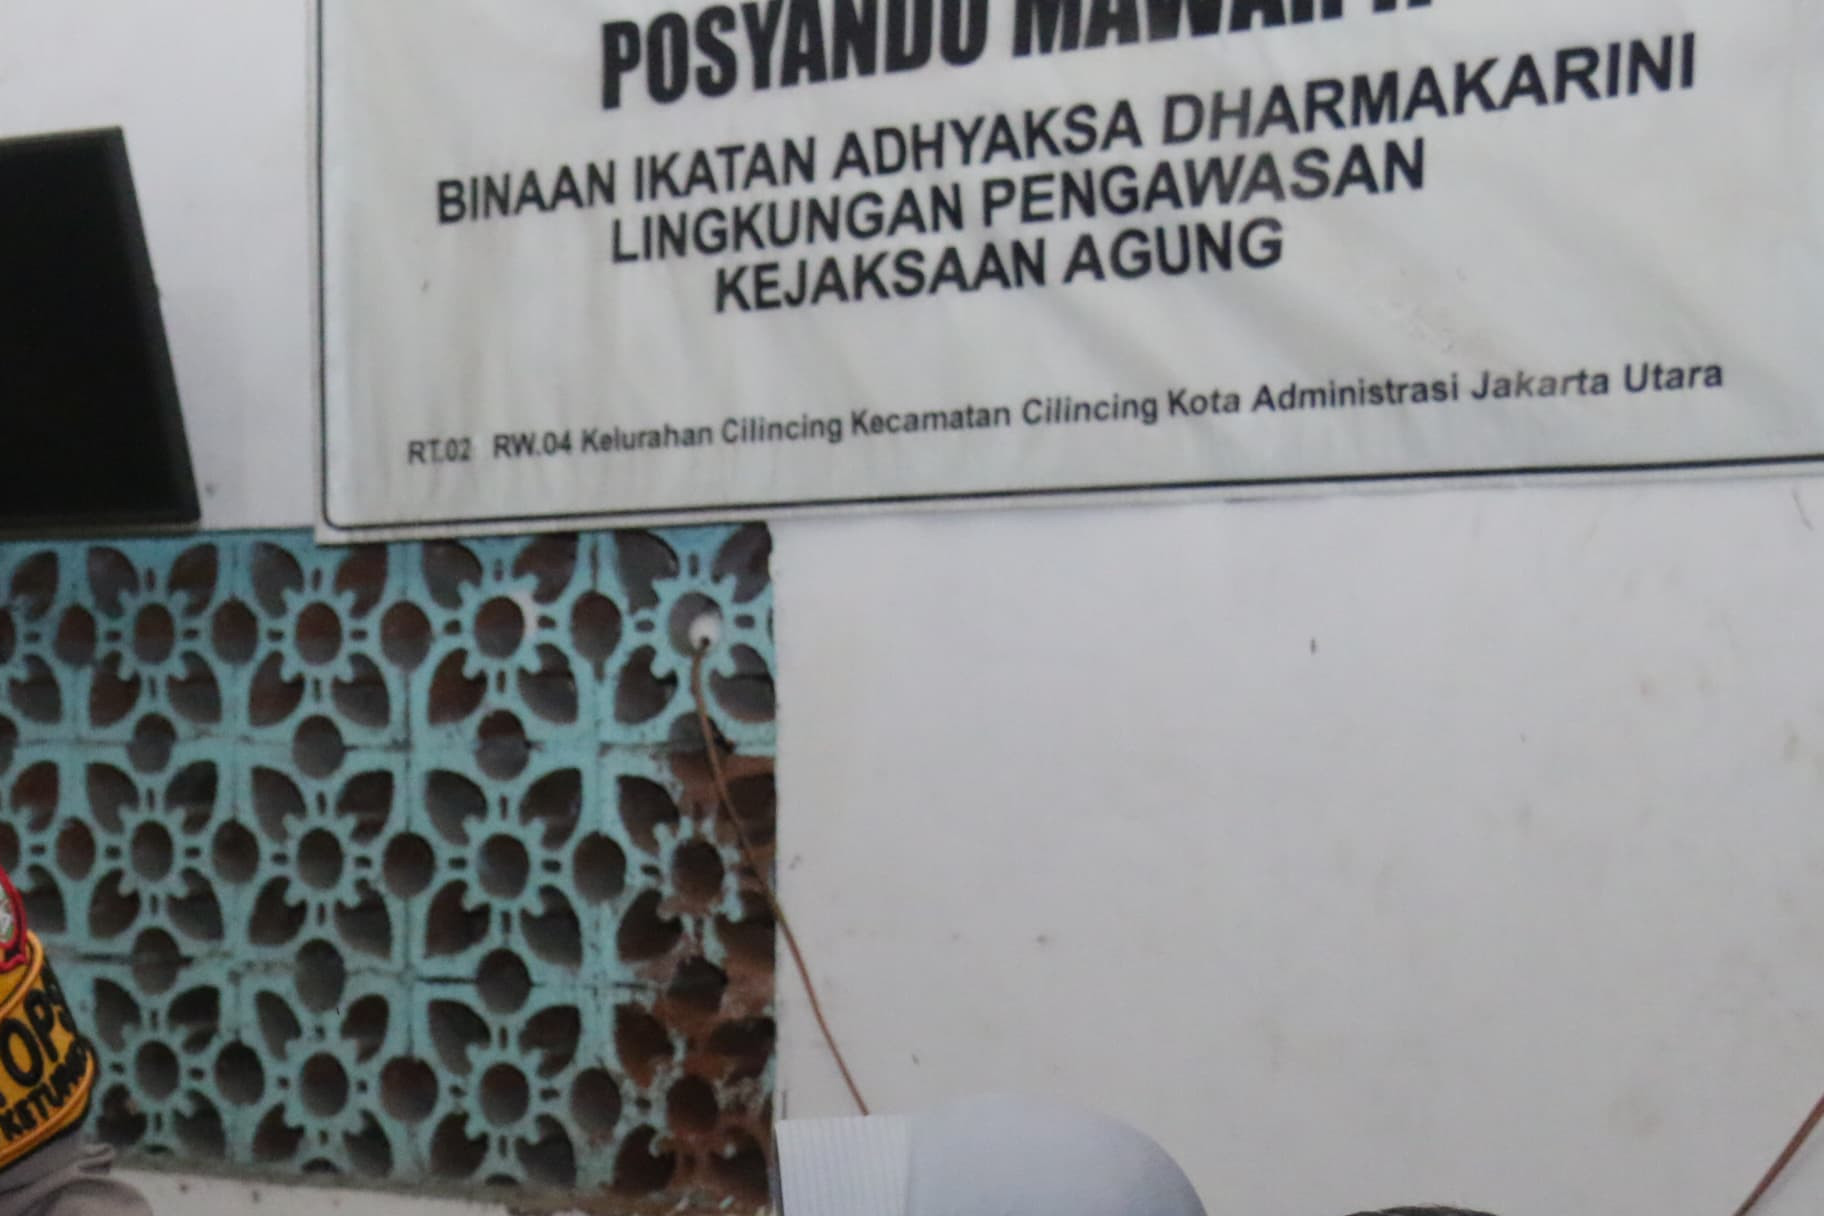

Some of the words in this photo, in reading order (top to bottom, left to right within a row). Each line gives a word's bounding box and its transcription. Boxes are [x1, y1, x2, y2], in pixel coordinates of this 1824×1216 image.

[600, 0, 988, 111] POSYANDU
[437, 159, 617, 225] BINAAN
[634, 136, 817, 201] IKATAN
[832, 98, 1143, 180] ADHYAKSA
[1162, 31, 1696, 145] DHARMAKARINI
[611, 183, 964, 264] LINGKUNGAN
[982, 137, 1425, 232] PENGAWASAN
[714, 237, 1046, 314] KEJAKSAAN
[1062, 217, 1283, 285] AGUNG
[407, 436, 472, 465] RT.02
[493, 429, 573, 459] RW.04
[580, 423, 714, 454] Kelurahan
[721, 413, 844, 445] Cilincing
[850, 404, 1011, 436] Kecamatan
[1022, 393, 1160, 427] Cilincing
[1167, 387, 1241, 418] Kota
[1251, 377, 1460, 413] Administrasi
[1470, 368, 1610, 401] Jakarta
[1623, 361, 1725, 394] Utara
